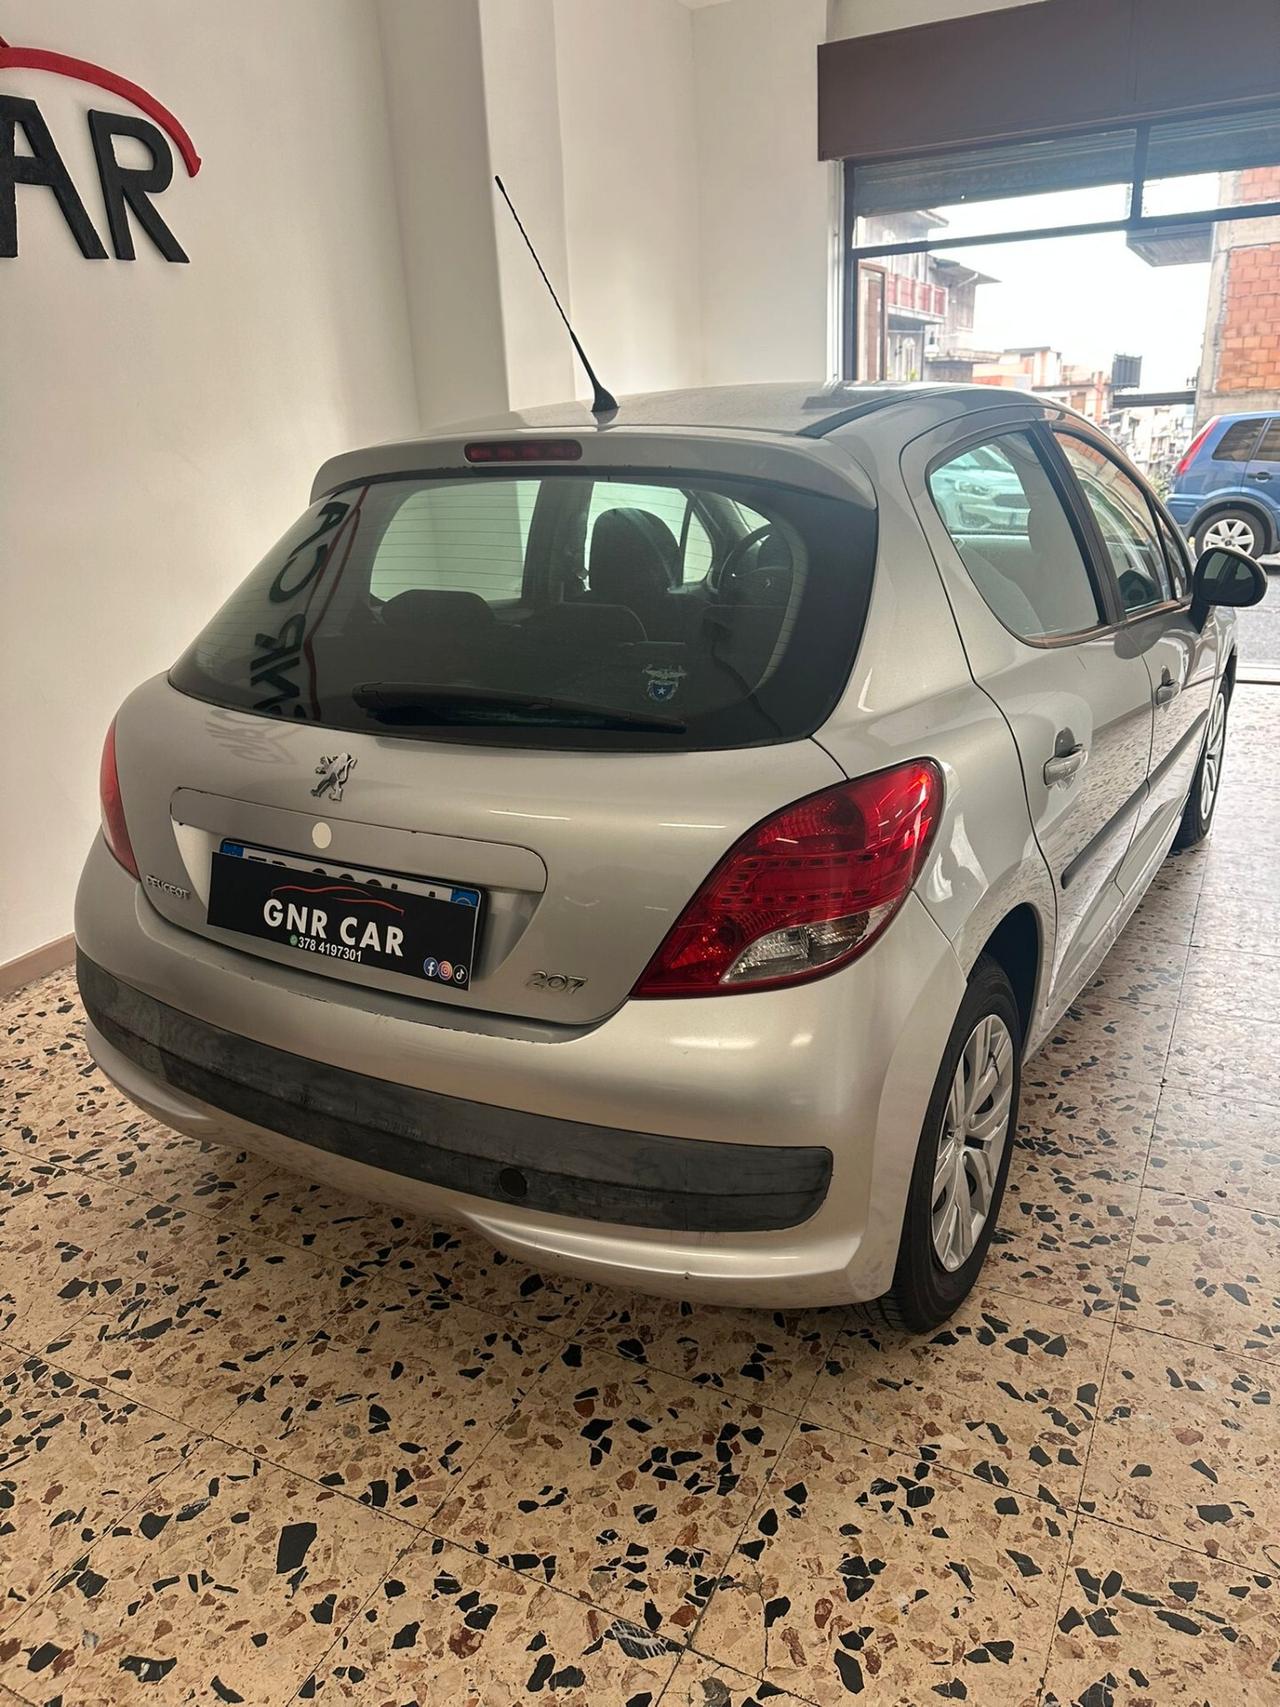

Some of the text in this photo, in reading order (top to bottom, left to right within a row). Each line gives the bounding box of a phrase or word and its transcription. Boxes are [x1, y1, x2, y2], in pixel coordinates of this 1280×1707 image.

[146, 874, 191, 900] PEUGEOT
[263, 898, 404, 957] GNR CAR
[298, 936, 362, 963] 378 4197301
[526, 970, 588, 994] 207
